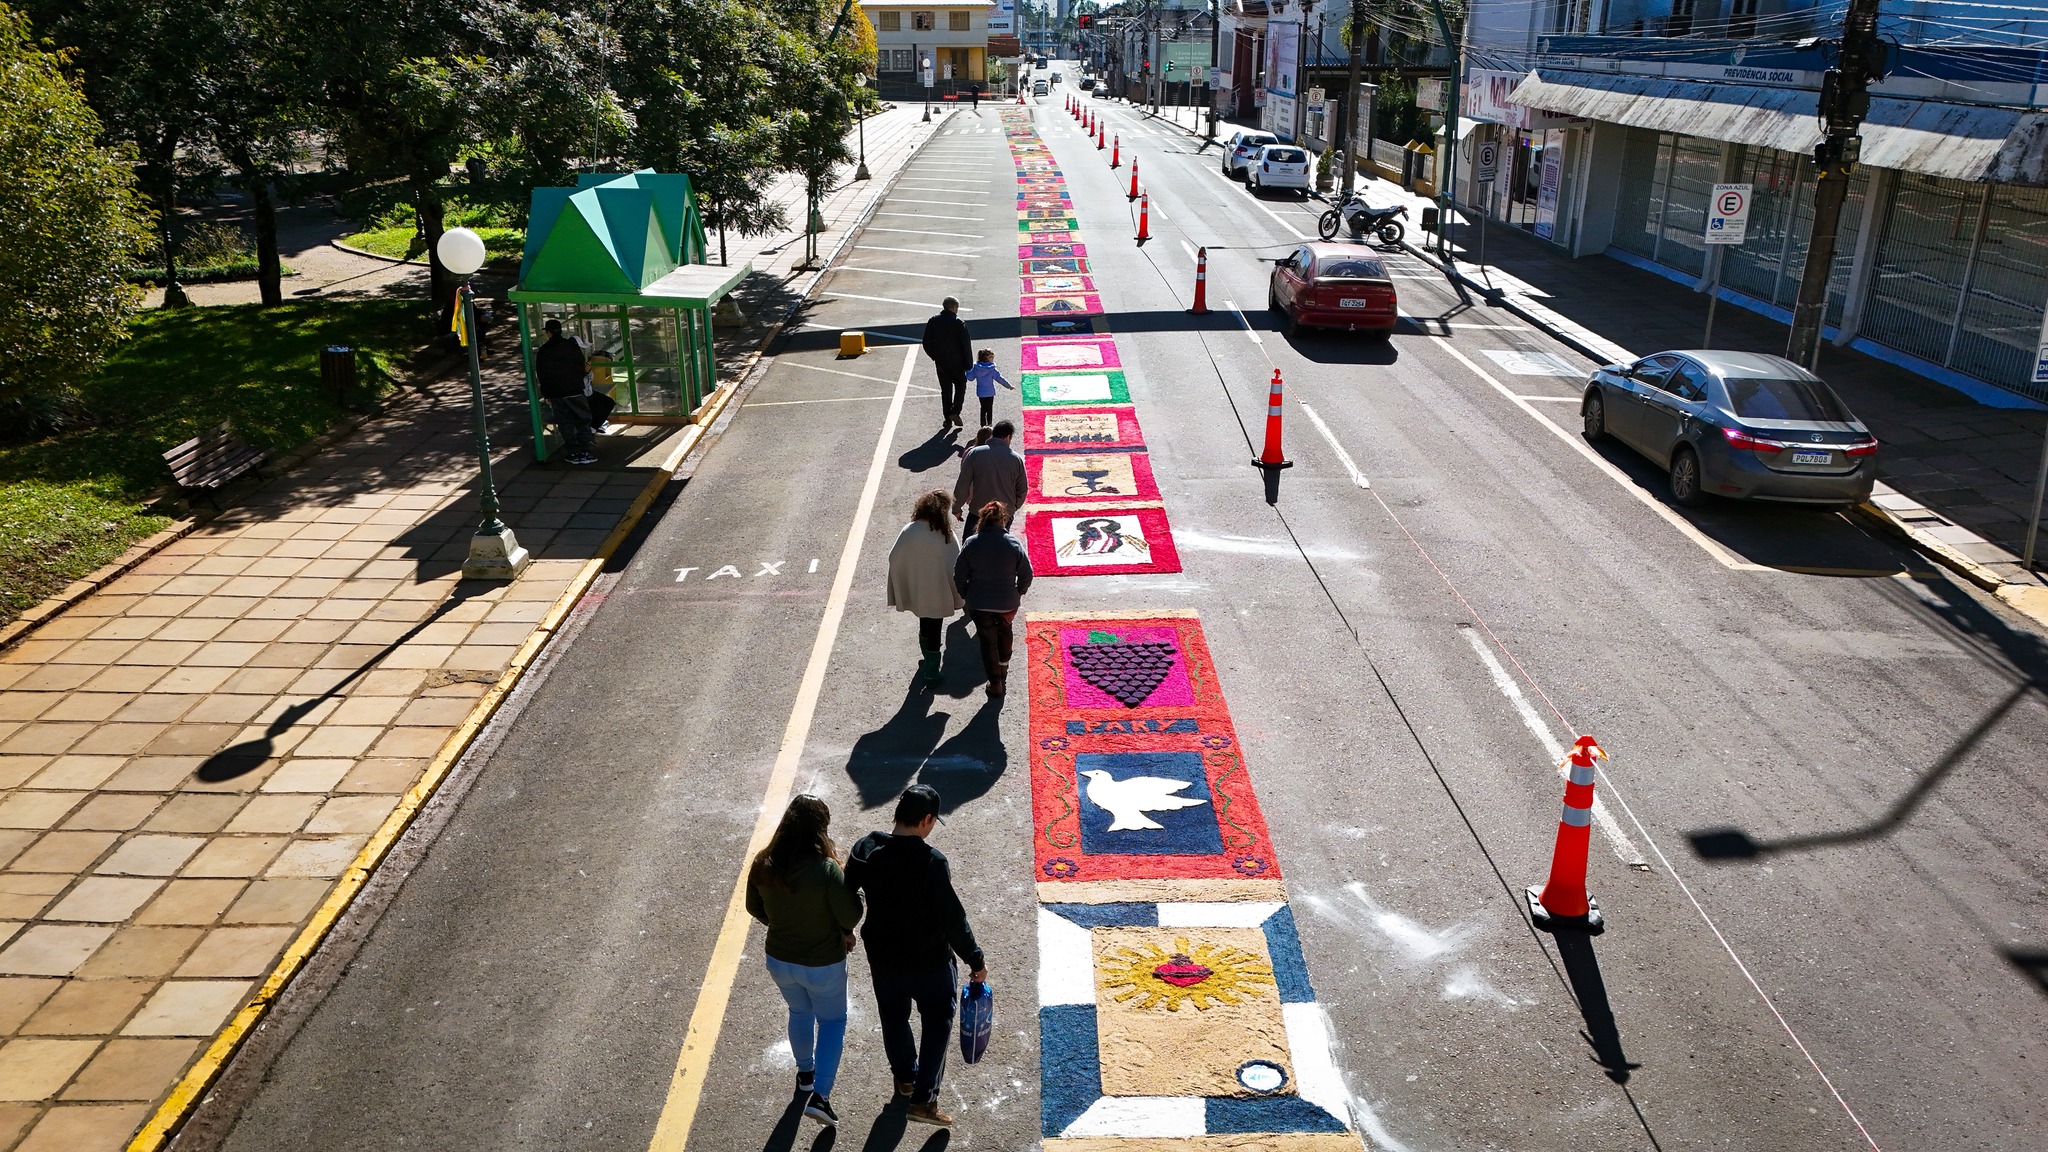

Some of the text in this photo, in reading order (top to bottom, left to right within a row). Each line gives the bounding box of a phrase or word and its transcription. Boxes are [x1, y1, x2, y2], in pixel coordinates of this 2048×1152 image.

[1723, 68, 1794, 82] PREVIDÊNCIA SOCIAL
[1484, 151, 1491, 162] E
[1724, 197, 1736, 210] E
[673, 558, 820, 583] TAXI
